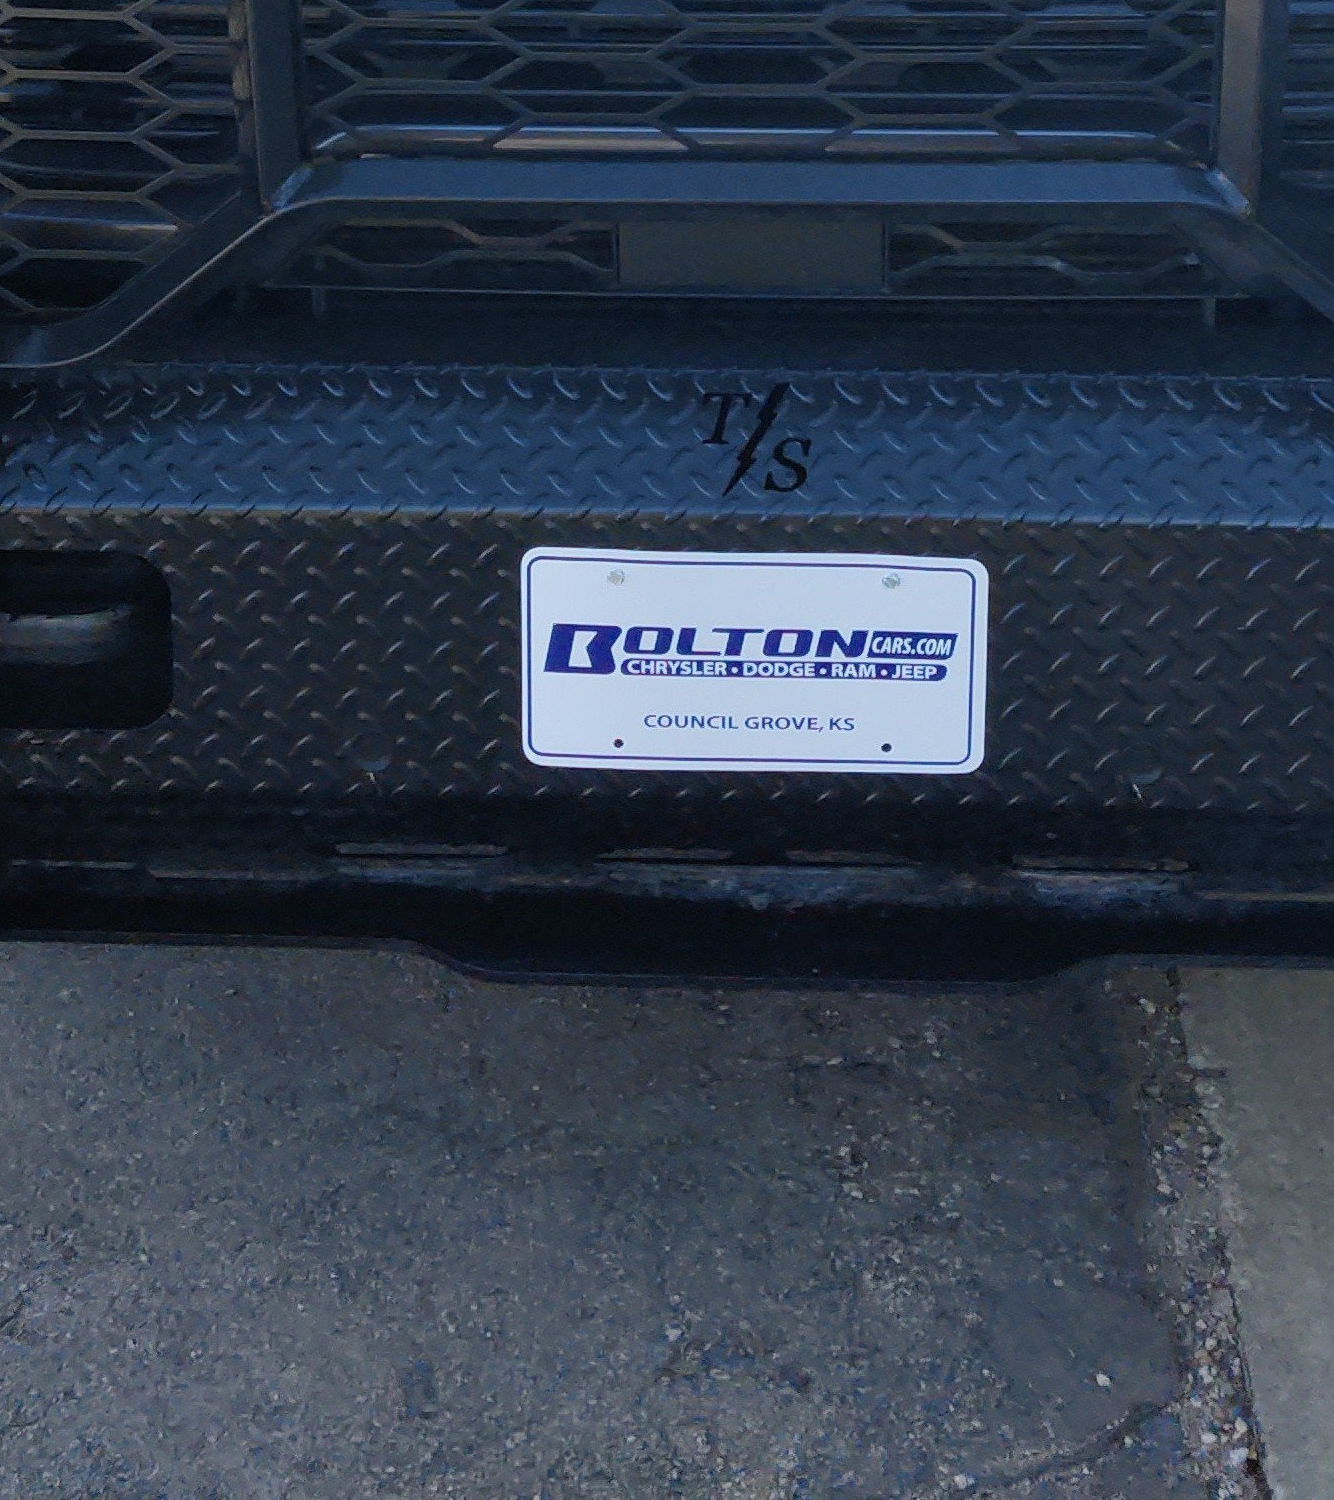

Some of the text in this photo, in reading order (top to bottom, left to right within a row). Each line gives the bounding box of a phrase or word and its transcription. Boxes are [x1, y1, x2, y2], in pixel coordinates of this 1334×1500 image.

[543, 623, 952, 675] BOLTON CARS.COM
[626, 660, 938, 680] CHRYSLER DODGE RAM JEEP
[643, 714, 856, 733] COUNCIL GROVE, KS
